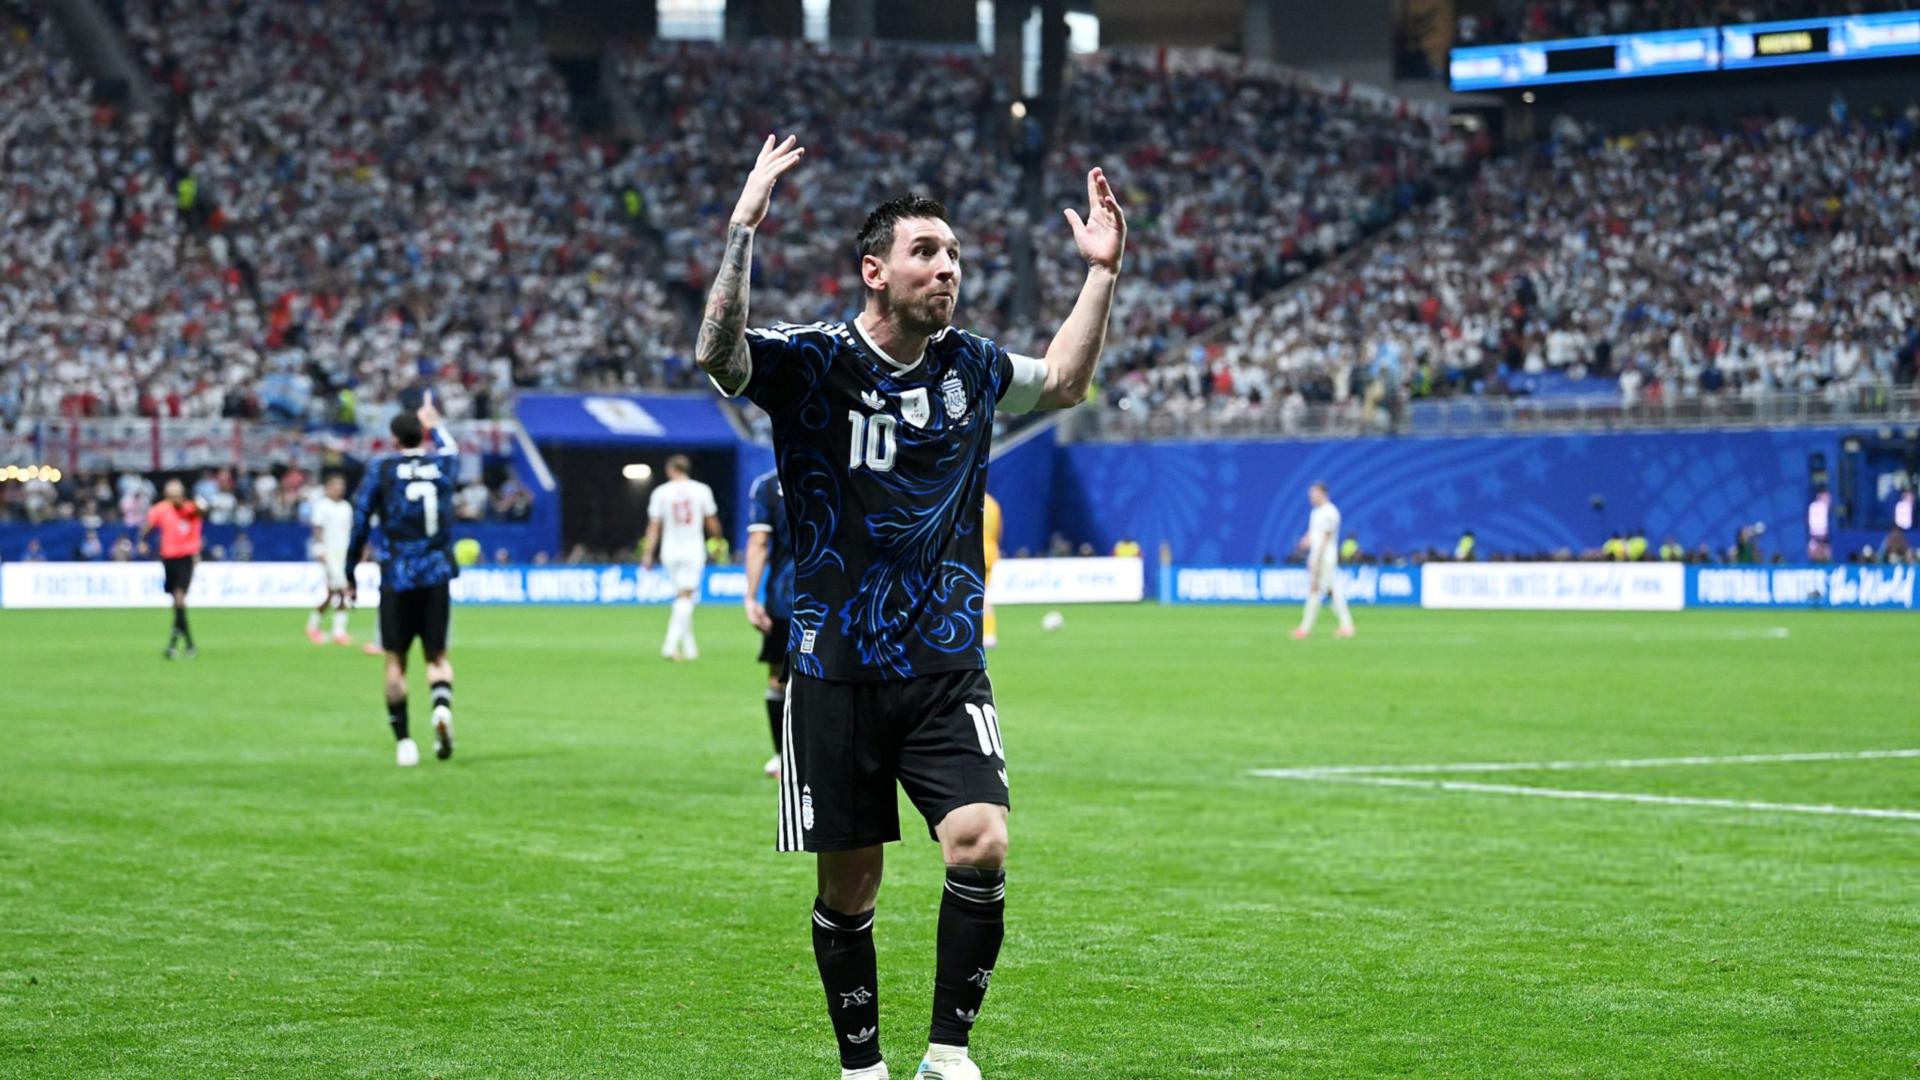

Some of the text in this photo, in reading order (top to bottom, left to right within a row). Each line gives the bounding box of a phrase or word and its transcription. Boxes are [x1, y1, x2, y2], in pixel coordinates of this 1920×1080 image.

[848, 409, 898, 472] 10
[405, 481, 438, 537] 7
[1177, 567, 1260, 601] FOOTBALL
[1698, 568, 1771, 603] FOOTBALL
